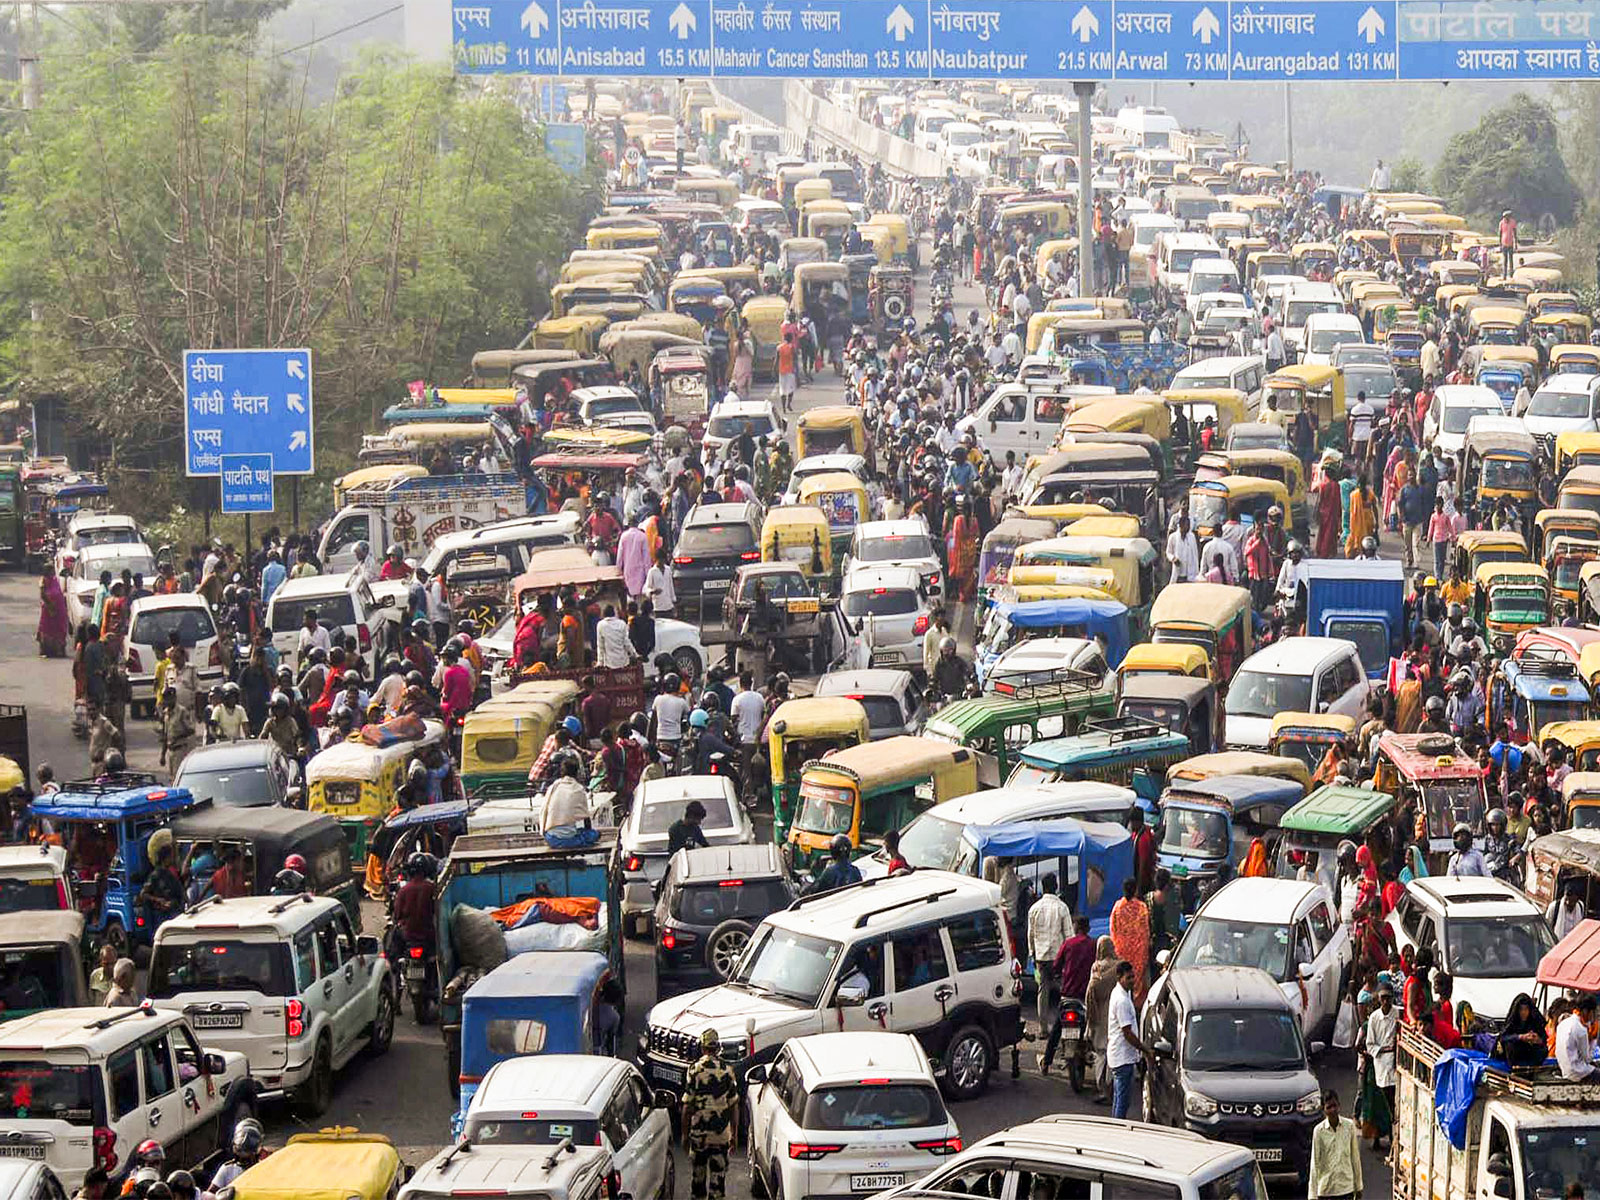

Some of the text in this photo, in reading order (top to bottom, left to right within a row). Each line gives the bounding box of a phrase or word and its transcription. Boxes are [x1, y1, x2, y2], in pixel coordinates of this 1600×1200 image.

[453, 7, 491, 32] एम्स
[561, 0, 650, 30] अनीसाबाद
[714, 2, 755, 32] महावीर
[800, 3, 841, 32] संस्थान
[932, 4, 1001, 41] नौबतपुर
[1116, 12, 1172, 34] अरवल
[1232, 5, 1316, 35] औरंगाबाद
[1404, 3, 1595, 38] पाटलि पथ
[516, 48, 530, 66] 11
[535, 48, 558, 66] KM
[563, 47, 710, 67] Anisabad 15.5 KM
[714, 47, 929, 69] Mahavir Cancer Sansthan 13.5 KM
[932, 49, 1112, 73] Naubatpur 21.5 KM
[1116, 50, 1227, 71] Arwal 73 KM
[1232, 51, 1396, 76] Aurangabad 131 KM
[1456, 49, 1519, 71] आपका
[1524, 49, 1582, 71] स्वागत
[191, 358, 224, 382] दीघा
[232, 390, 269, 414] मैदान
[193, 430, 222, 450] एम्स
[224, 464, 269, 486] पाटलि पथ
